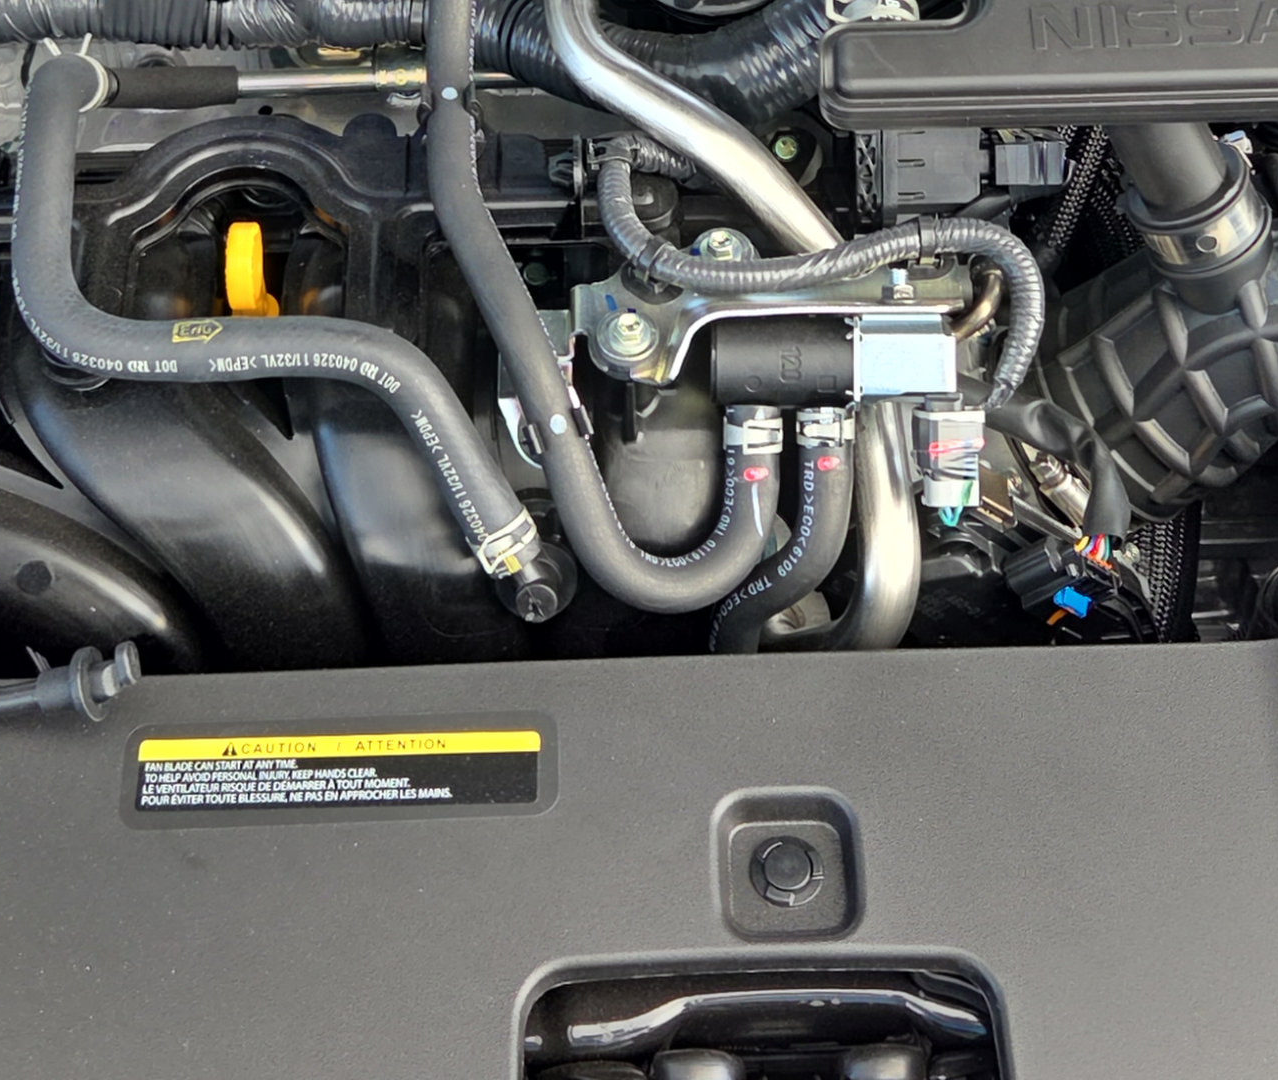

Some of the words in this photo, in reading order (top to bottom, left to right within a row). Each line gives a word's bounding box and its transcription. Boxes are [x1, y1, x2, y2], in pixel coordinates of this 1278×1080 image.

[72, 350, 124, 373] 040326
[154, 359, 178, 373] DOT
[209, 357, 257, 372] >EPDM<
[313, 353, 358, 372] 040326
[376, 371, 402, 394] DOT
[410, 409, 443, 454] >EPDM<
[241, 743, 317, 754] CAUTION
[355, 739, 446, 752] ATTENTION
[144, 762, 163, 772] FAN
[165, 762, 193, 771] BLADE
[195, 761, 214, 771] CAN
[215, 761, 241, 770] START
[243, 761, 255, 770] AT
[255, 760, 275, 769] ANY
[145, 774, 158, 783] TO
[159, 774, 181, 783] HELP
[183, 773, 211, 782] AVOID
[212, 772, 257, 781] PERSONAL
[292, 770, 313, 779] KEEP
[315, 769, 346, 779] HANDS
[143, 785, 154, 794] LE
[156, 783, 220, 793] VENTILATEUR
[221, 783, 256, 792] RISQUE
[258, 782, 271, 791] DE
[273, 780, 326, 790] DÉMARRER
[336, 779, 363, 789] TOUT
[365, 778, 411, 788] MOMENT.
[141, 796, 170, 806] POUR
[171, 793, 204, 805] ÉVITER
[206, 794, 237, 804] TOUTE
[289, 793, 303, 802] NE
[305, 792, 323, 802] PAS
[324, 791, 339, 801] EN
[340, 789, 399, 801] APPROCHER
[400, 789, 417, 799] LES
[418, 788, 453, 799] MAINS.
